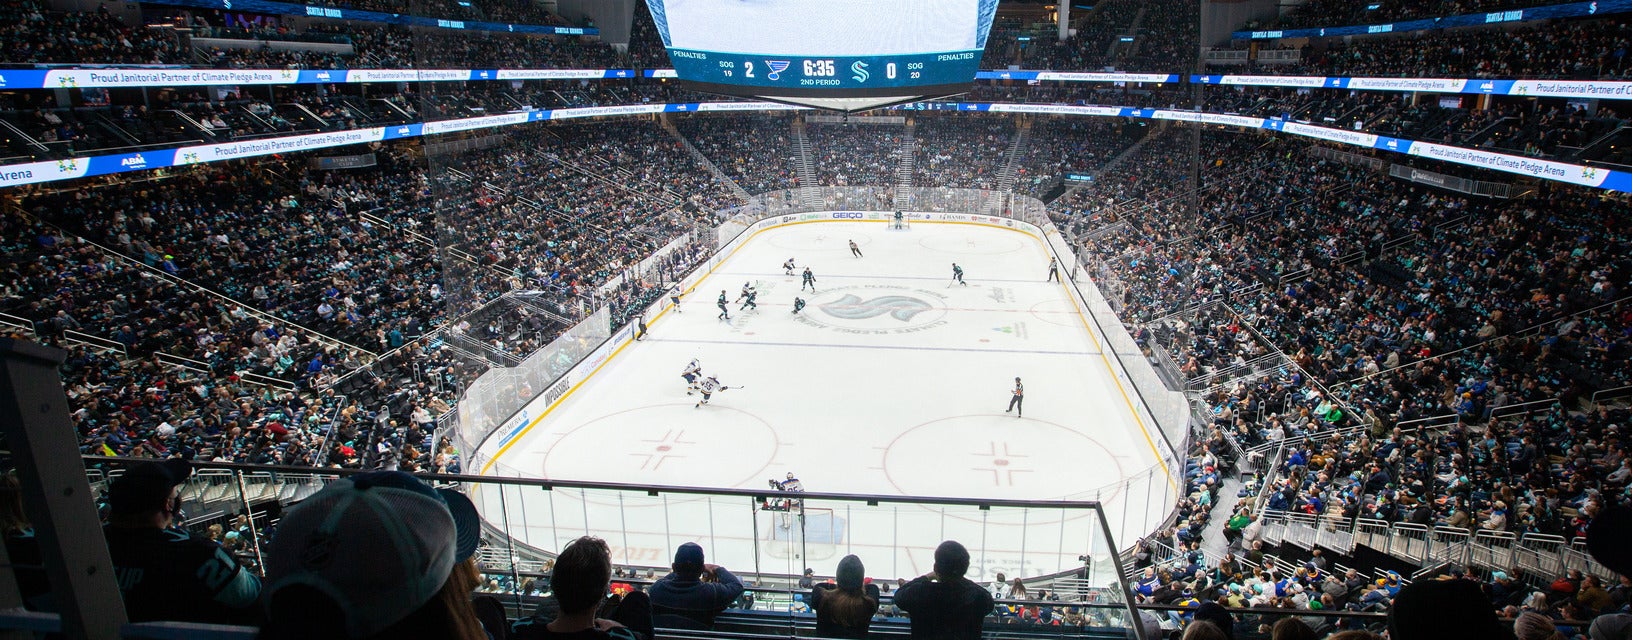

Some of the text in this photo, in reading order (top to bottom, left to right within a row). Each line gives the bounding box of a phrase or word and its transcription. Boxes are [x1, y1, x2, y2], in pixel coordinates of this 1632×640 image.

[674, 50, 706, 60] PENALTIES
[938, 52, 974, 62] PENALTIES
[719, 60, 734, 69] SOG
[744, 61, 755, 78] 2
[803, 59, 834, 77] 6:35
[886, 62, 896, 79] 0
[91, 72, 272, 82] Proud Janitorial Partner of Climate Pledge Arena
[1536, 84, 1555, 92] Proud
[1556, 84, 1587, 93] Janitorial
[1587, 84, 1614, 94] Partner
[1616, 86, 1626, 94] of
[215, 146, 238, 156] Proud
[239, 144, 270, 154] Janitorial
[272, 141, 295, 150] Partner
[304, 137, 326, 146] Climate
[326, 135, 346, 144] Pledge
[122, 158, 146, 166] ABM
[1430, 146, 1566, 176] Proud Janitorial Partner of Climate Pledge Arena
[0, 170, 32, 181] Arena
[196, 547, 236, 590] 21
